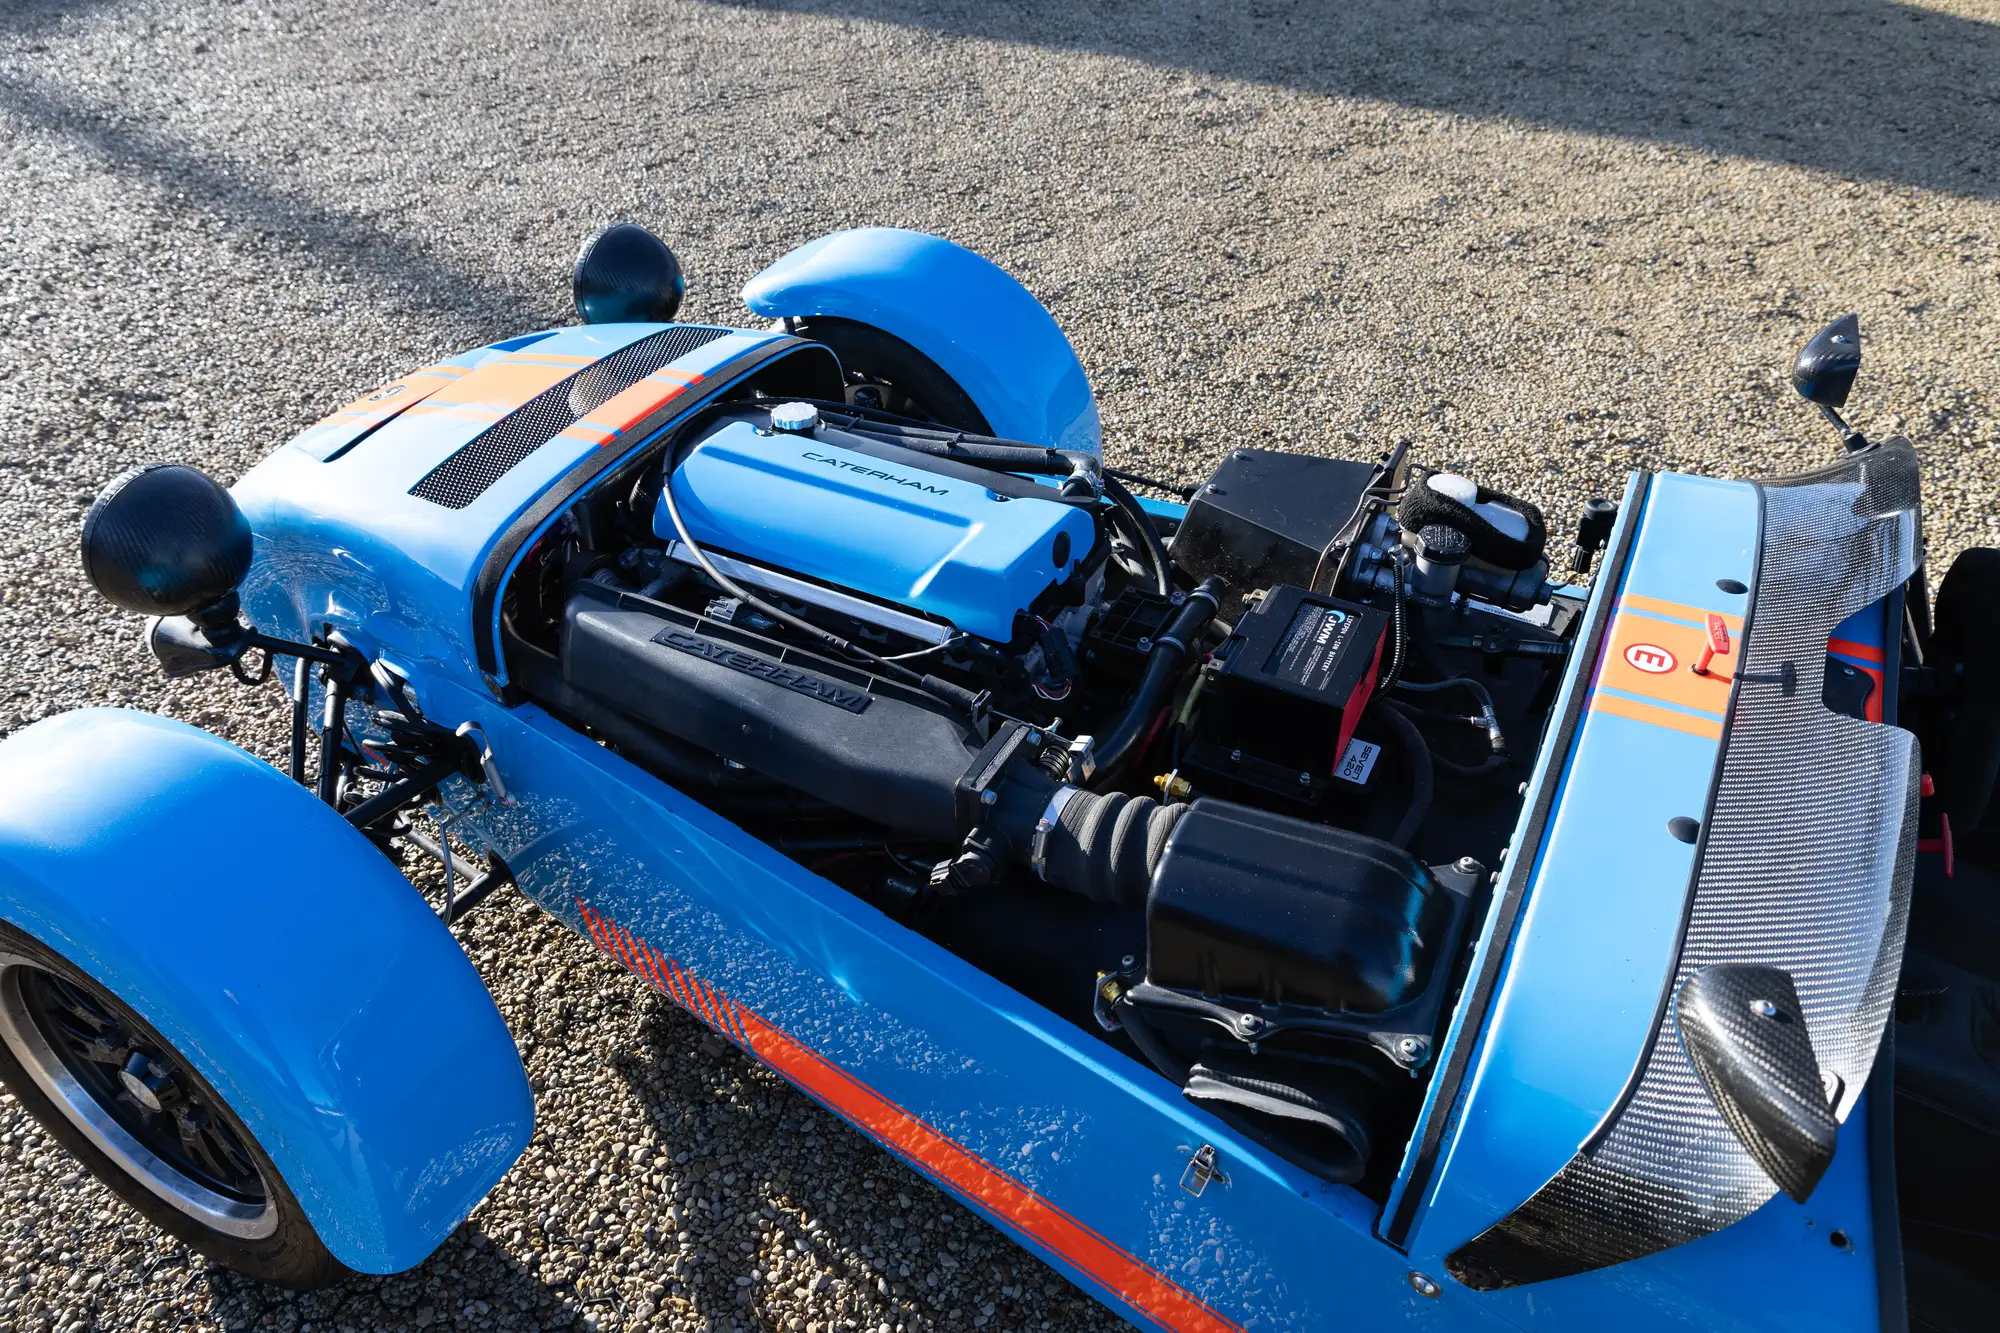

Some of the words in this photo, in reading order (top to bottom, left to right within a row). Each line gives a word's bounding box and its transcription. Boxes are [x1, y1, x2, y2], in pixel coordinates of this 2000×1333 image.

[802, 452, 949, 496] CATERHAM
[1317, 616, 1337, 645] JWM
[663, 632, 862, 706] CATERHAM
[1321, 651, 1336, 672] BATTERY
[1634, 649, 1665, 667] E
[1343, 755, 1357, 776] 420
[1351, 745, 1373, 780] SEVEN
